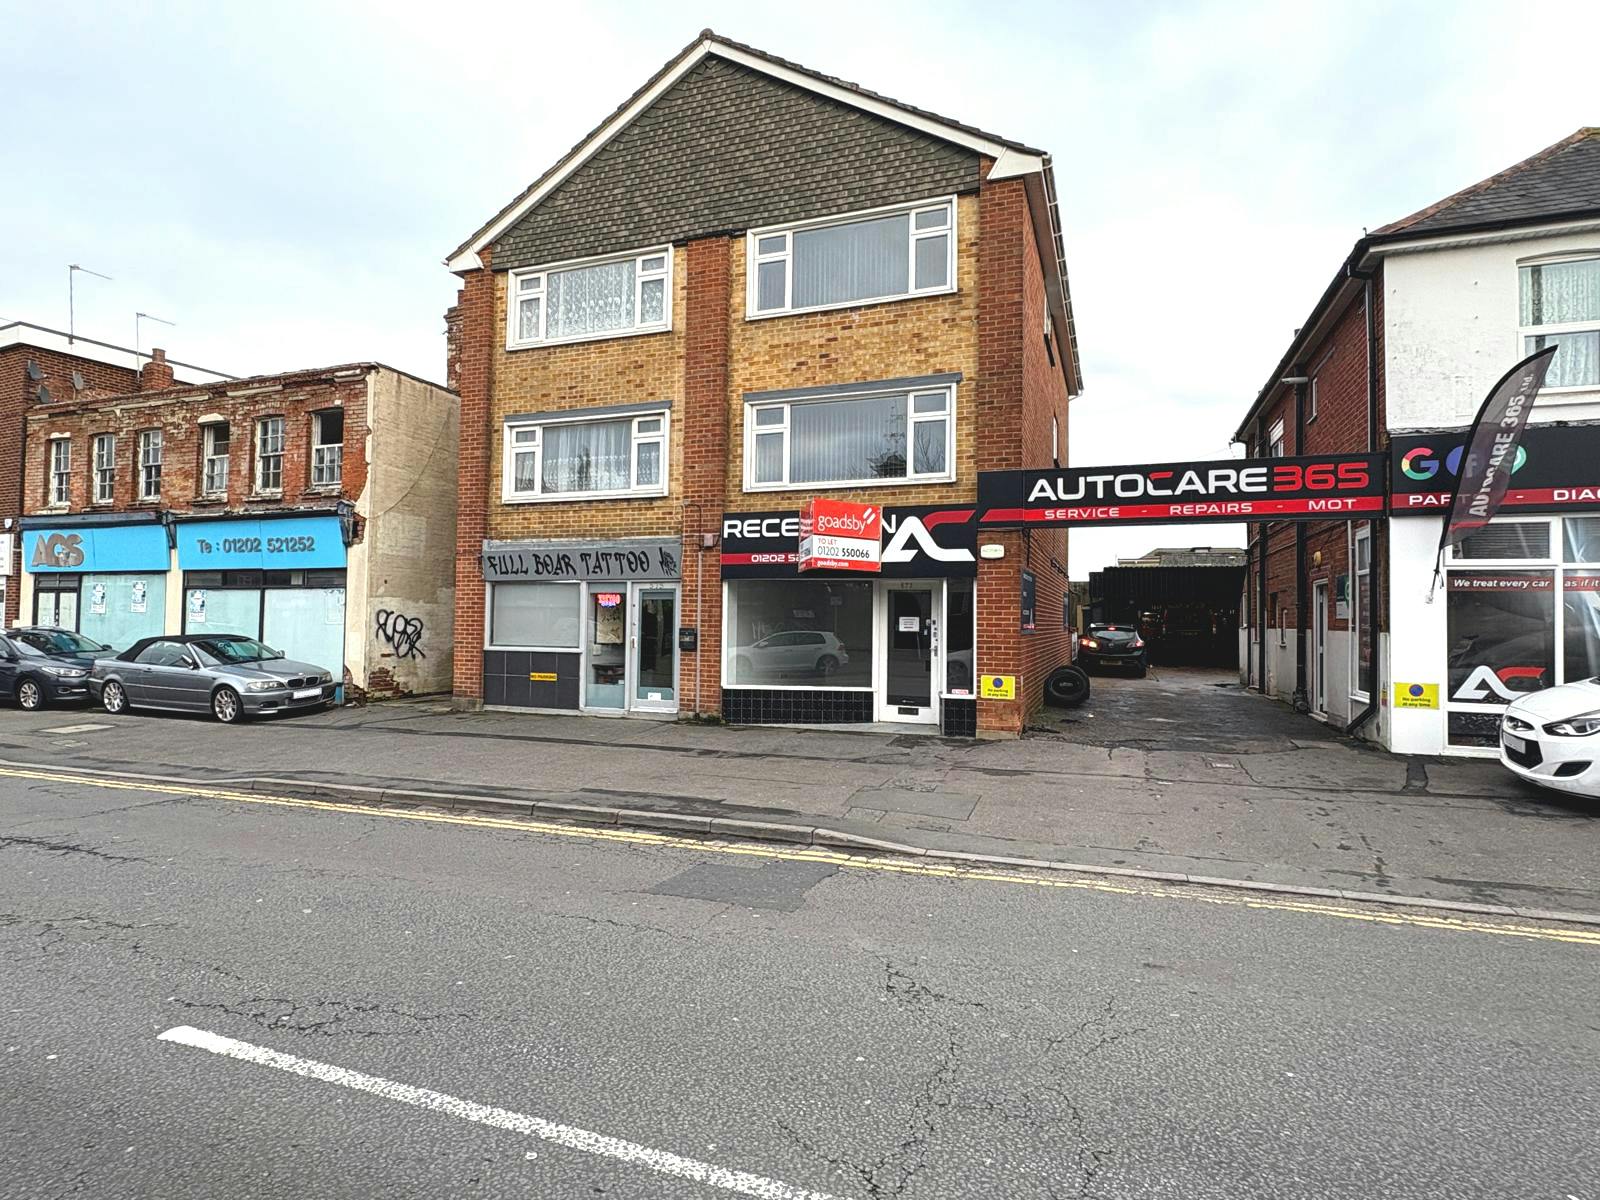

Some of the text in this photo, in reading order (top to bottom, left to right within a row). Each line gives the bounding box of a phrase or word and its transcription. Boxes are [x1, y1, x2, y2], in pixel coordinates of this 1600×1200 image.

[1501, 396, 1526, 428] 365
[1028, 462, 1369, 502] AUTOCARE 365
[1553, 489, 1600, 501] DIA
[1045, 507, 1120, 519] SERVICE
[1170, 503, 1253, 515] REPAIRS
[1308, 499, 1357, 511] MOT
[818, 513, 865, 535] goadsby
[222, 538, 262, 553] 01202
[267, 536, 316, 553] 521252
[817, 546, 840, 557] 01202
[842, 548, 870, 559] 550066
[487, 550, 650, 576] FULL BOAR TATTOO
[751, 554, 786, 563] 01202
[817, 560, 849, 569] goadsby.com
[1454, 579, 1471, 587] We
[1473, 579, 1498, 588] treat
[1500, 580, 1530, 589] every
[1581, 579, 1589, 587] if
